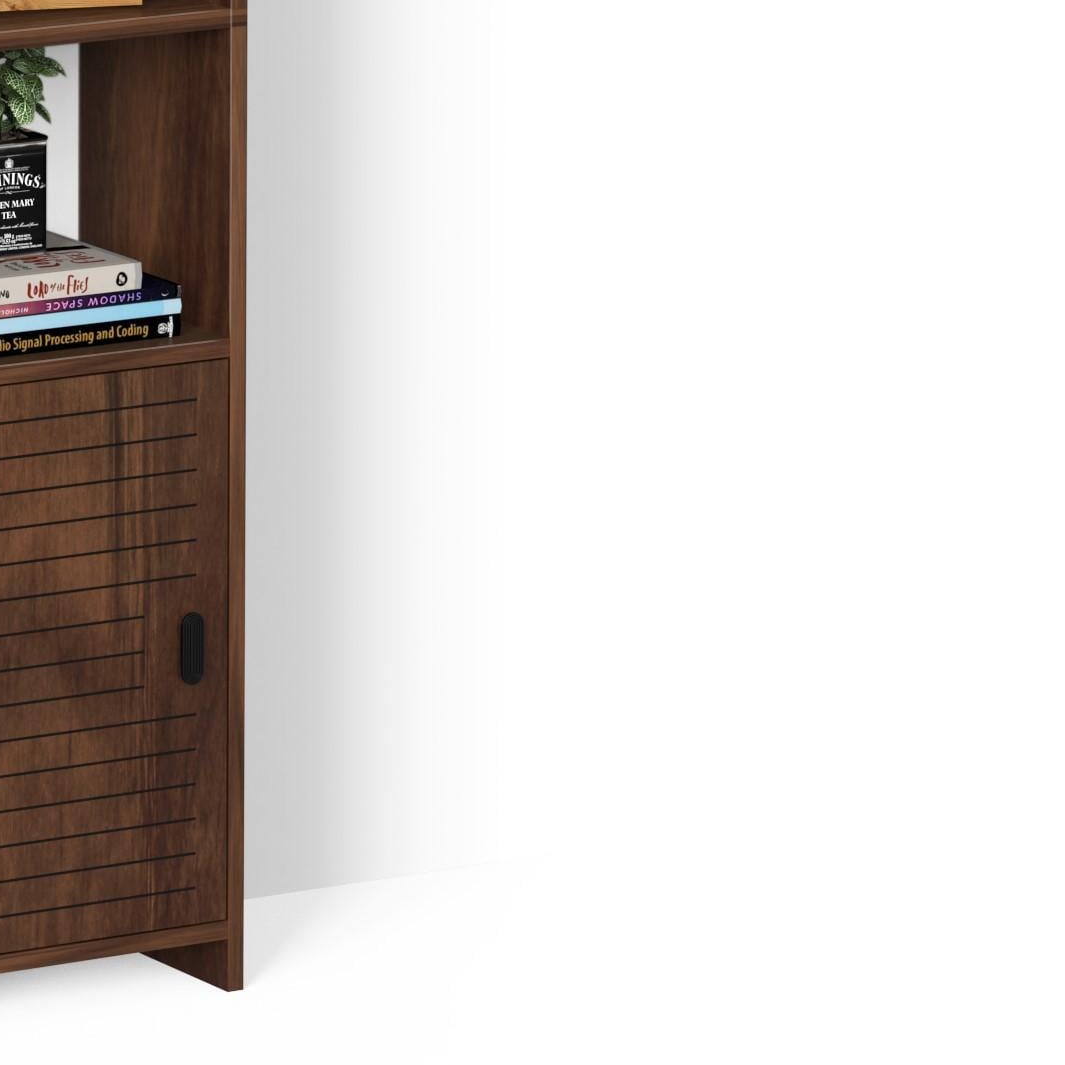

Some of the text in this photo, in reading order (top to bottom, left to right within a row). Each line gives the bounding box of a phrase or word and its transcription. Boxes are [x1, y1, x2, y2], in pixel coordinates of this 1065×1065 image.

[11, 198, 35, 209] MARY
[1, 211, 17, 220] TEA
[45, 291, 142, 312] SHADOW SPACE
[12, 334, 43, 353] Signal
[44, 329, 94, 347] Processing
[96, 326, 115, 341] and
[116, 323, 149, 338] Coding
